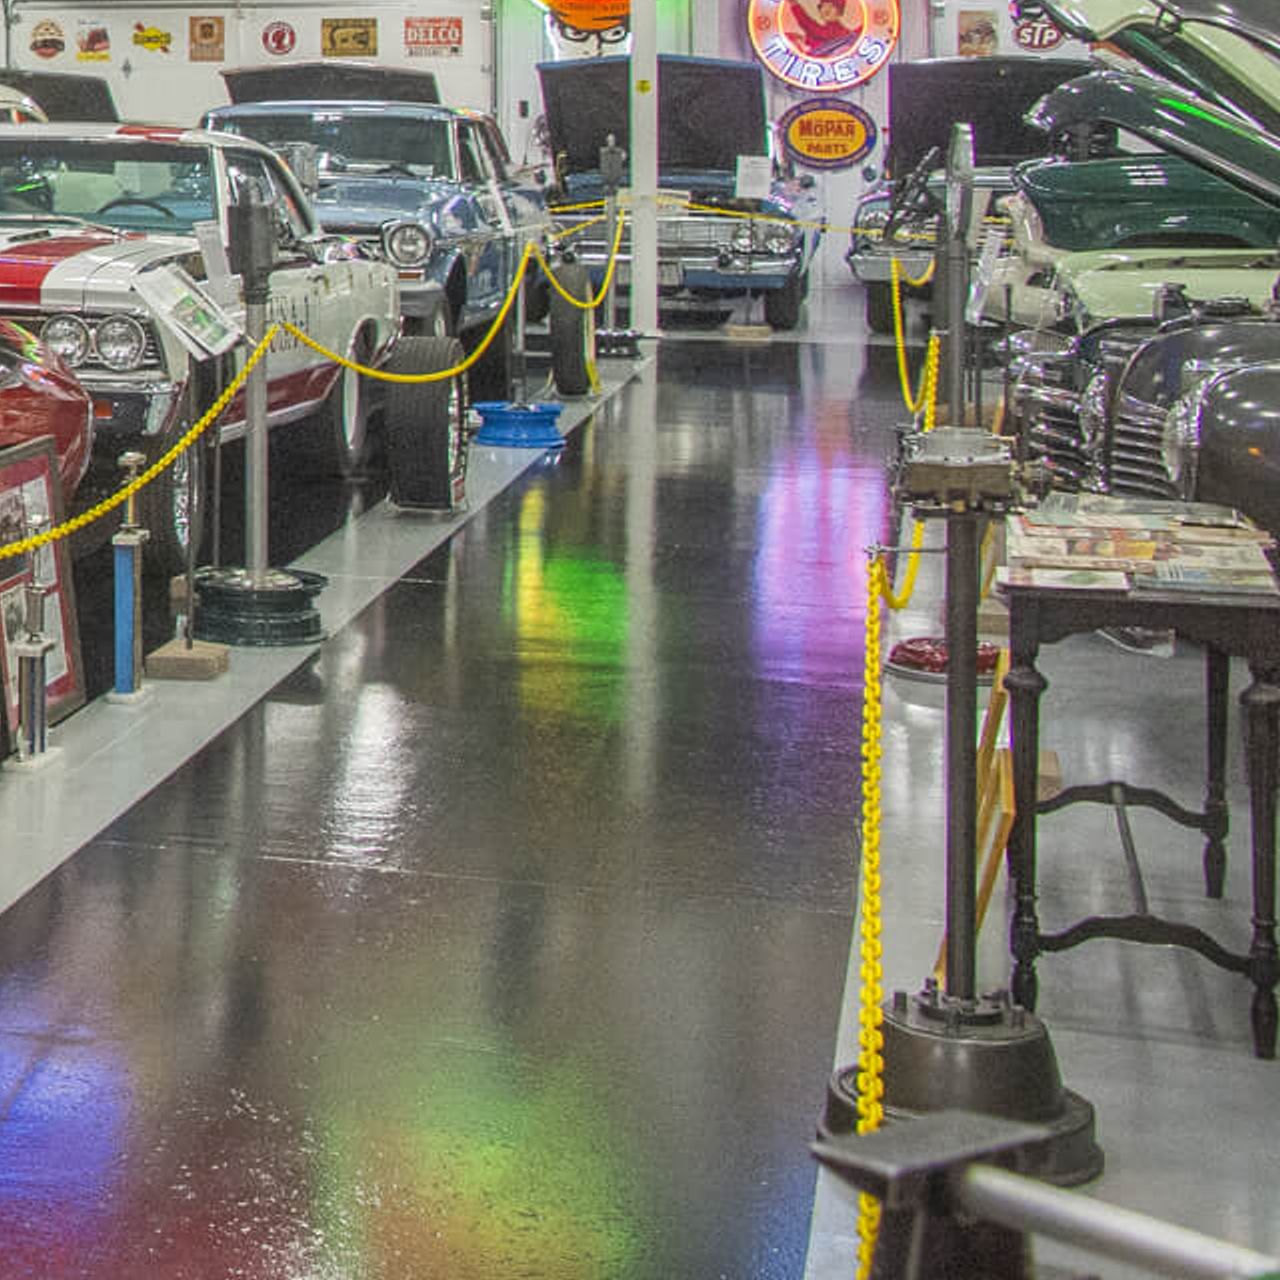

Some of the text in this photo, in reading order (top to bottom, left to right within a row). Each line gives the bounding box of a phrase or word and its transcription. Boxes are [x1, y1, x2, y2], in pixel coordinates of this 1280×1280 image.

[407, 27, 460, 44] DELCO
[1019, 24, 1060, 45] STP
[765, 36, 885, 86] TIRES
[806, 142, 848, 154] PARTS
